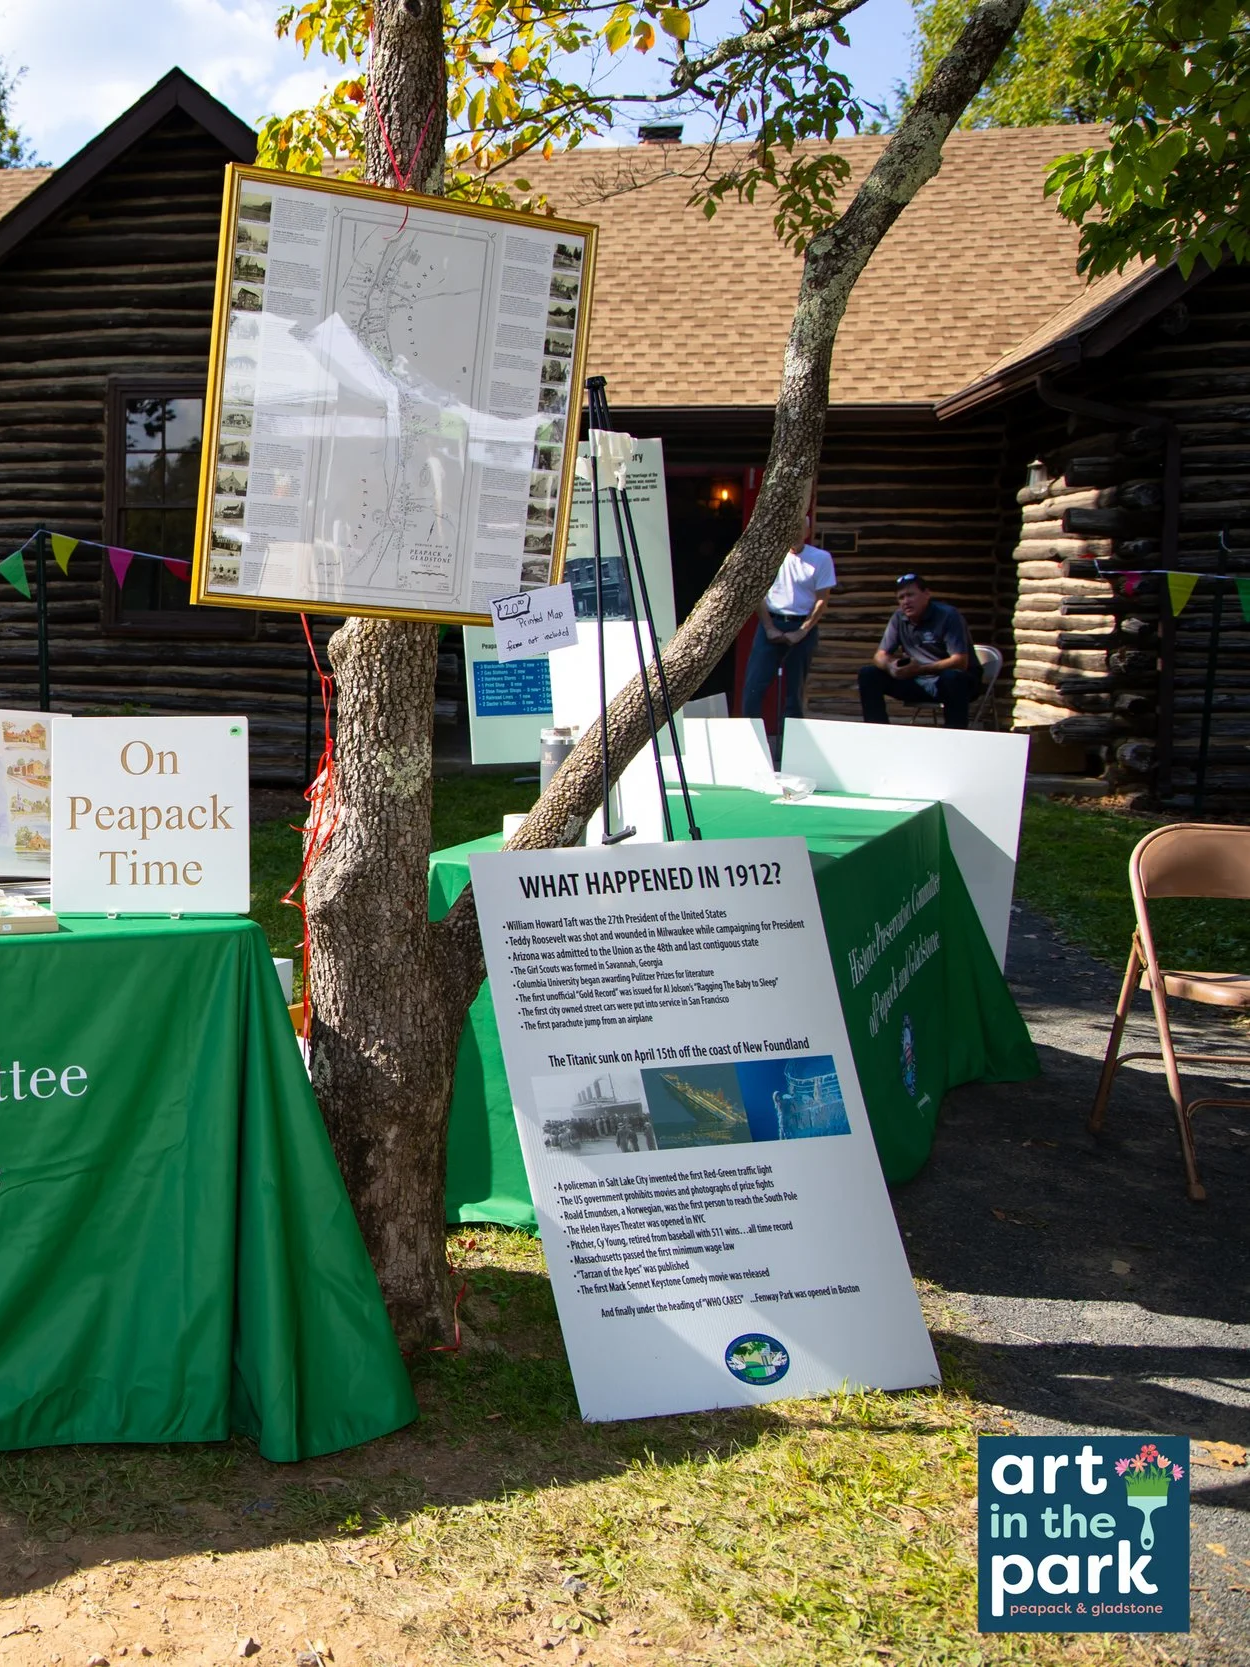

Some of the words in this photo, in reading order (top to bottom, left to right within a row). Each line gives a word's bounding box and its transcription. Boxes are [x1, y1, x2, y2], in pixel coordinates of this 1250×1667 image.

[516, 612, 543, 628] Printed
[548, 610, 563, 620] Map
[120, 741, 180, 775] On
[67, 794, 235, 840] Peapack
[99, 851, 202, 886] Time
[518, 873, 582, 898] WHAT
[584, 867, 695, 894] HAPPENED
[696, 866, 720, 888] IN
[723, 862, 784, 886] 1912?
[506, 920, 534, 930] William
[534, 918, 563, 928] Howard
[563, 917, 578, 926] Taft
[593, 916, 606, 925] the
[606, 914, 624, 924] 27th
[624, 912, 658, 923] President
[658, 912, 667, 921] of
[667, 911, 680, 920] the
[680, 909, 704, 919] United
[704, 908, 727, 918] States
[849, 932, 876, 988] Historic
[875, 897, 911, 956] Preservation
[912, 871, 940, 915] Committee
[873, 967, 898, 1024] Peapack
[899, 949, 910, 992] and
[909, 931, 940, 977] Gladstone
[523, 1021, 536, 1030] The
[536, 1020, 550, 1029] first
[550, 1018, 584, 1029] parachute
[583, 1017, 601, 1028] jump
[601, 1016, 617, 1024] from
[626, 1013, 653, 1024] airplane
[548, 1055, 566, 1067] The
[566, 1052, 597, 1065] Titanic
[597, 1051, 620, 1063] sunk
[620, 1053, 633, 1062] on
[632, 1048, 656, 1063] April
[656, 1046, 677, 1059] 15th
[677, 1045, 692, 1058] off
[691, 1044, 707, 1056] the
[707, 1044, 731, 1055] coast
[731, 1041, 744, 1054] of
[742, 1041, 763, 1053] New
[762, 1036, 809, 1051] Foundland
[603, 1267, 611, 1277] of
[611, 1266, 623, 1276] the
[656, 1260, 689, 1273] published
